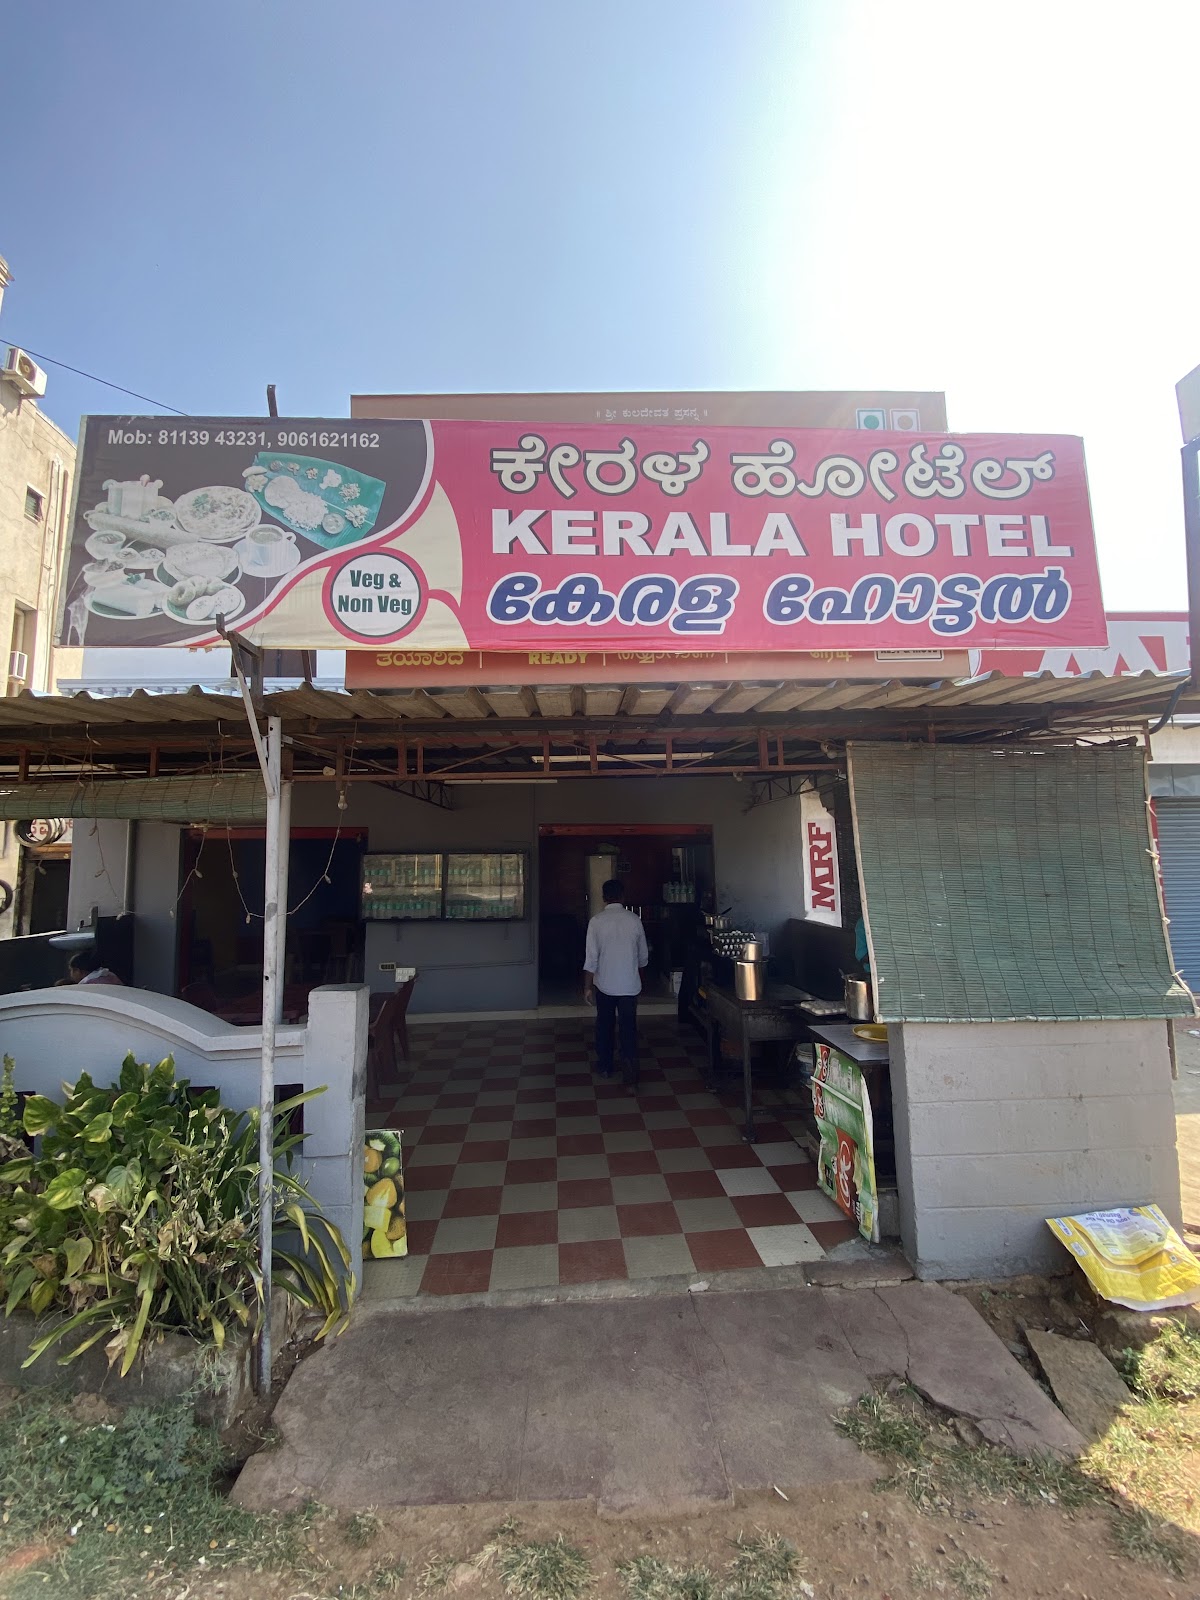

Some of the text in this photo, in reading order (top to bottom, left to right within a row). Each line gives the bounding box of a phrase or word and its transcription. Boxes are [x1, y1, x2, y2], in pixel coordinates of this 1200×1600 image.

[108, 429, 380, 449] Mob: 81139 43231, 9061621162
[490, 433, 1056, 503] ಕೇರಳ ಹೋಟೆಲ್
[492, 508, 1075, 557] KERALA HOTEL
[349, 569, 402, 590] Veg &
[337, 594, 412, 616] Non Veg
[486, 566, 1072, 636] കേരള ഹോട്ടൽ
[528, 652, 588, 665] READY
[808, 823, 836, 912] MRF
